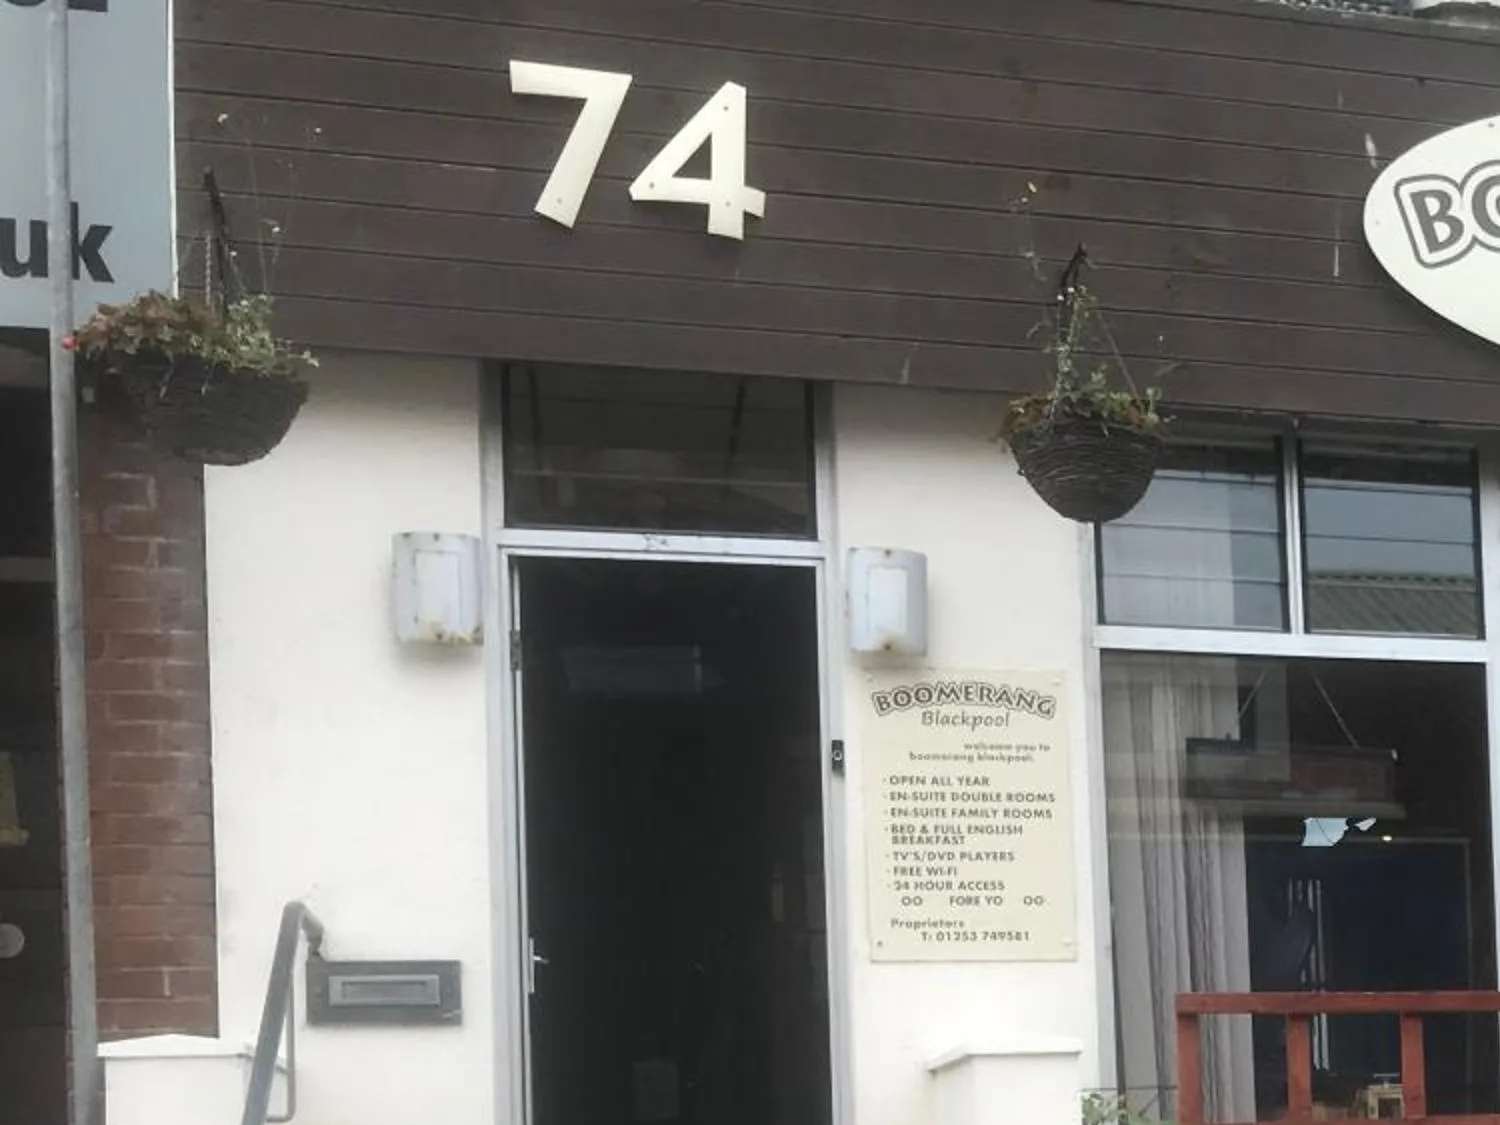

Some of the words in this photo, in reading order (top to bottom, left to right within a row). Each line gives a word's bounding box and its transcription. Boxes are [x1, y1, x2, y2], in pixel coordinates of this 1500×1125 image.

[508, 59, 766, 241] 74
[872, 681, 1056, 720] BOOMERANG
[921, 710, 1010, 732] Blackpool
[889, 775, 927, 785] OPEN
[930, 775, 953, 786] ALL
[957, 775, 991, 787] YEAR
[889, 791, 947, 802] EN-SUITE
[951, 792, 1002, 803] DOUBLE
[1006, 792, 1056, 804] ROOMS
[890, 807, 947, 818] EN-SUITE
[951, 807, 998, 819] FAMILY
[1003, 808, 1053, 820] ROOMS
[890, 823, 916, 835] BED
[919, 823, 929, 834] &
[933, 824, 963, 835] FULL
[967, 825, 1023, 836] ENGLISH
[892, 834, 966, 845] BREAKFAST
[959, 851, 1016, 862] PLAYERS
[893, 866, 923, 877] FREE
[893, 880, 910, 891] 24
[914, 880, 953, 891] HOUR
[957, 880, 1006, 892] ACCESS
[891, 918, 965, 931] Proprietors
[936, 931, 978, 941] 01253
